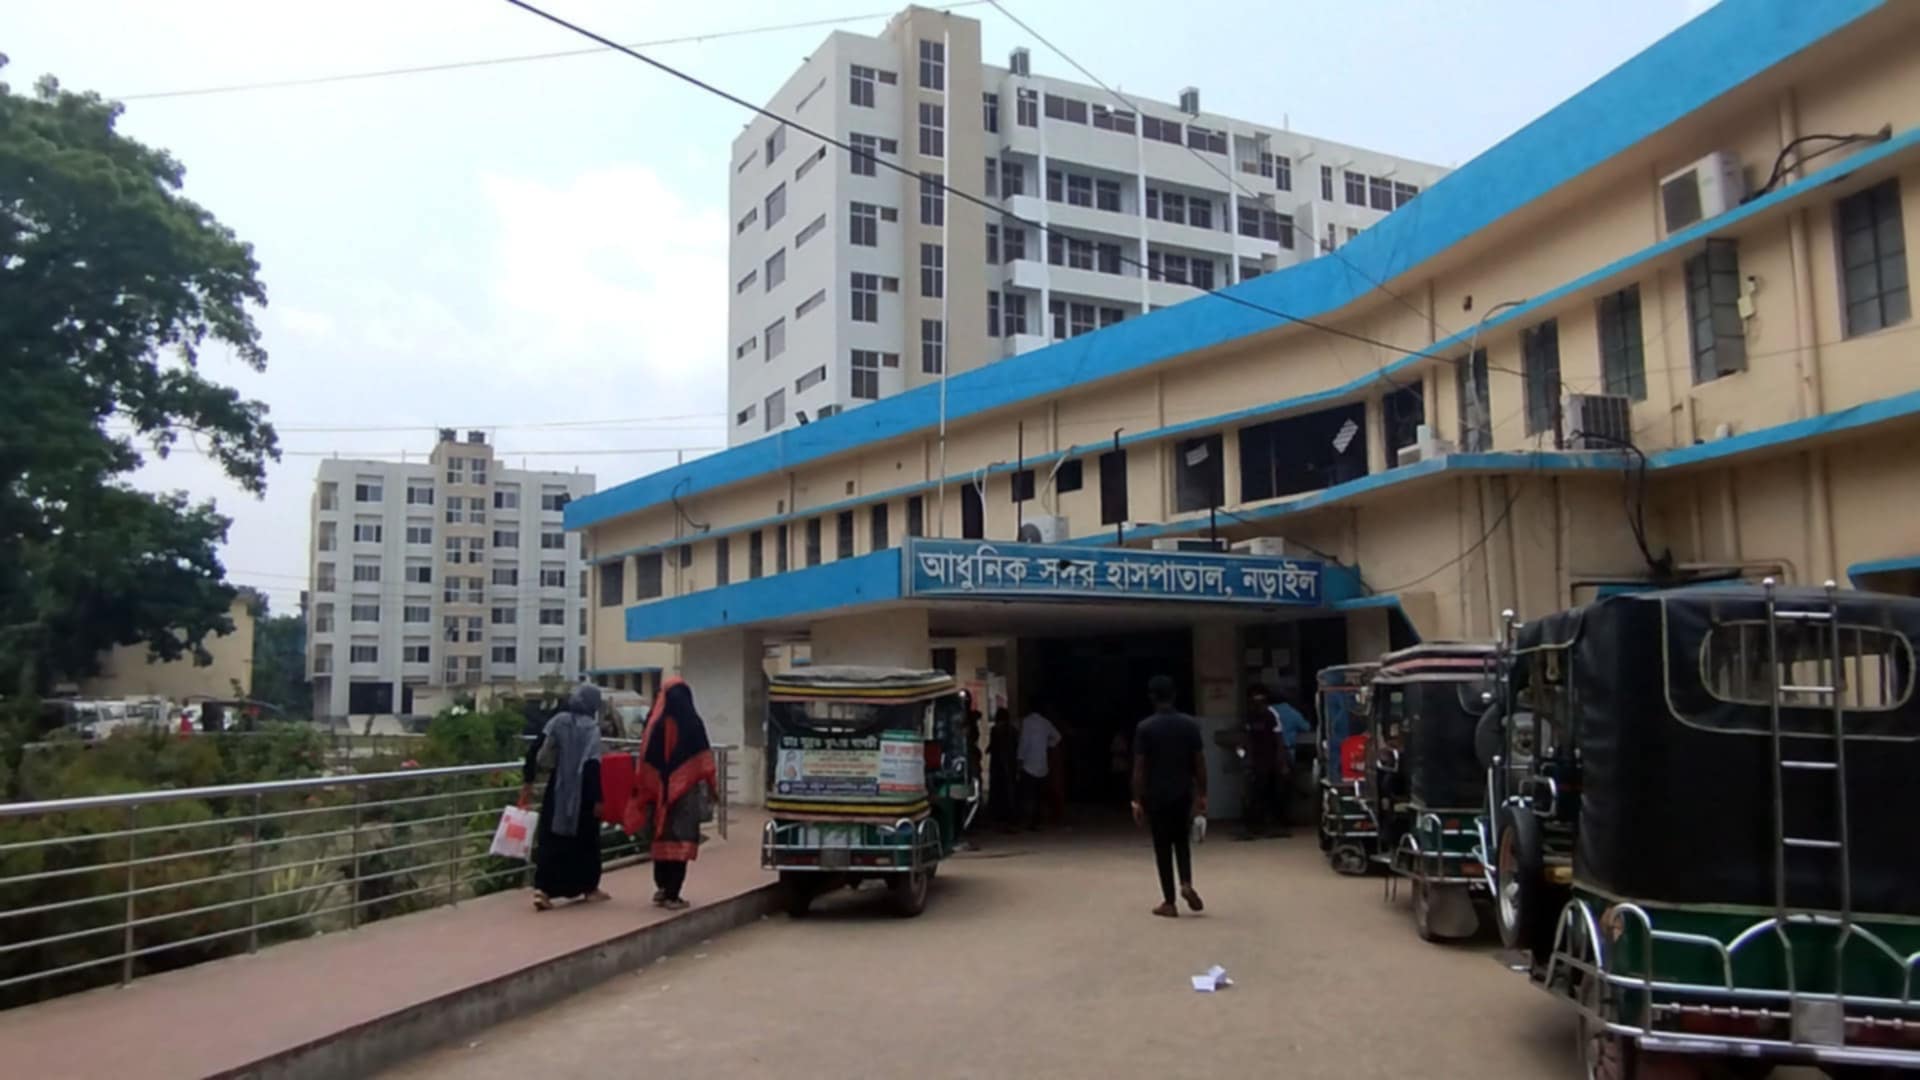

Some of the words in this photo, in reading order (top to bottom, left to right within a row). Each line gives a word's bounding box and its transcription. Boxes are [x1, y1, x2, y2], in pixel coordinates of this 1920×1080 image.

[917, 545, 1030, 592] আধুনিক
[1104, 557, 1233, 599] হাসপাতাল,
[1241, 561, 1319, 600] নড়াইল
